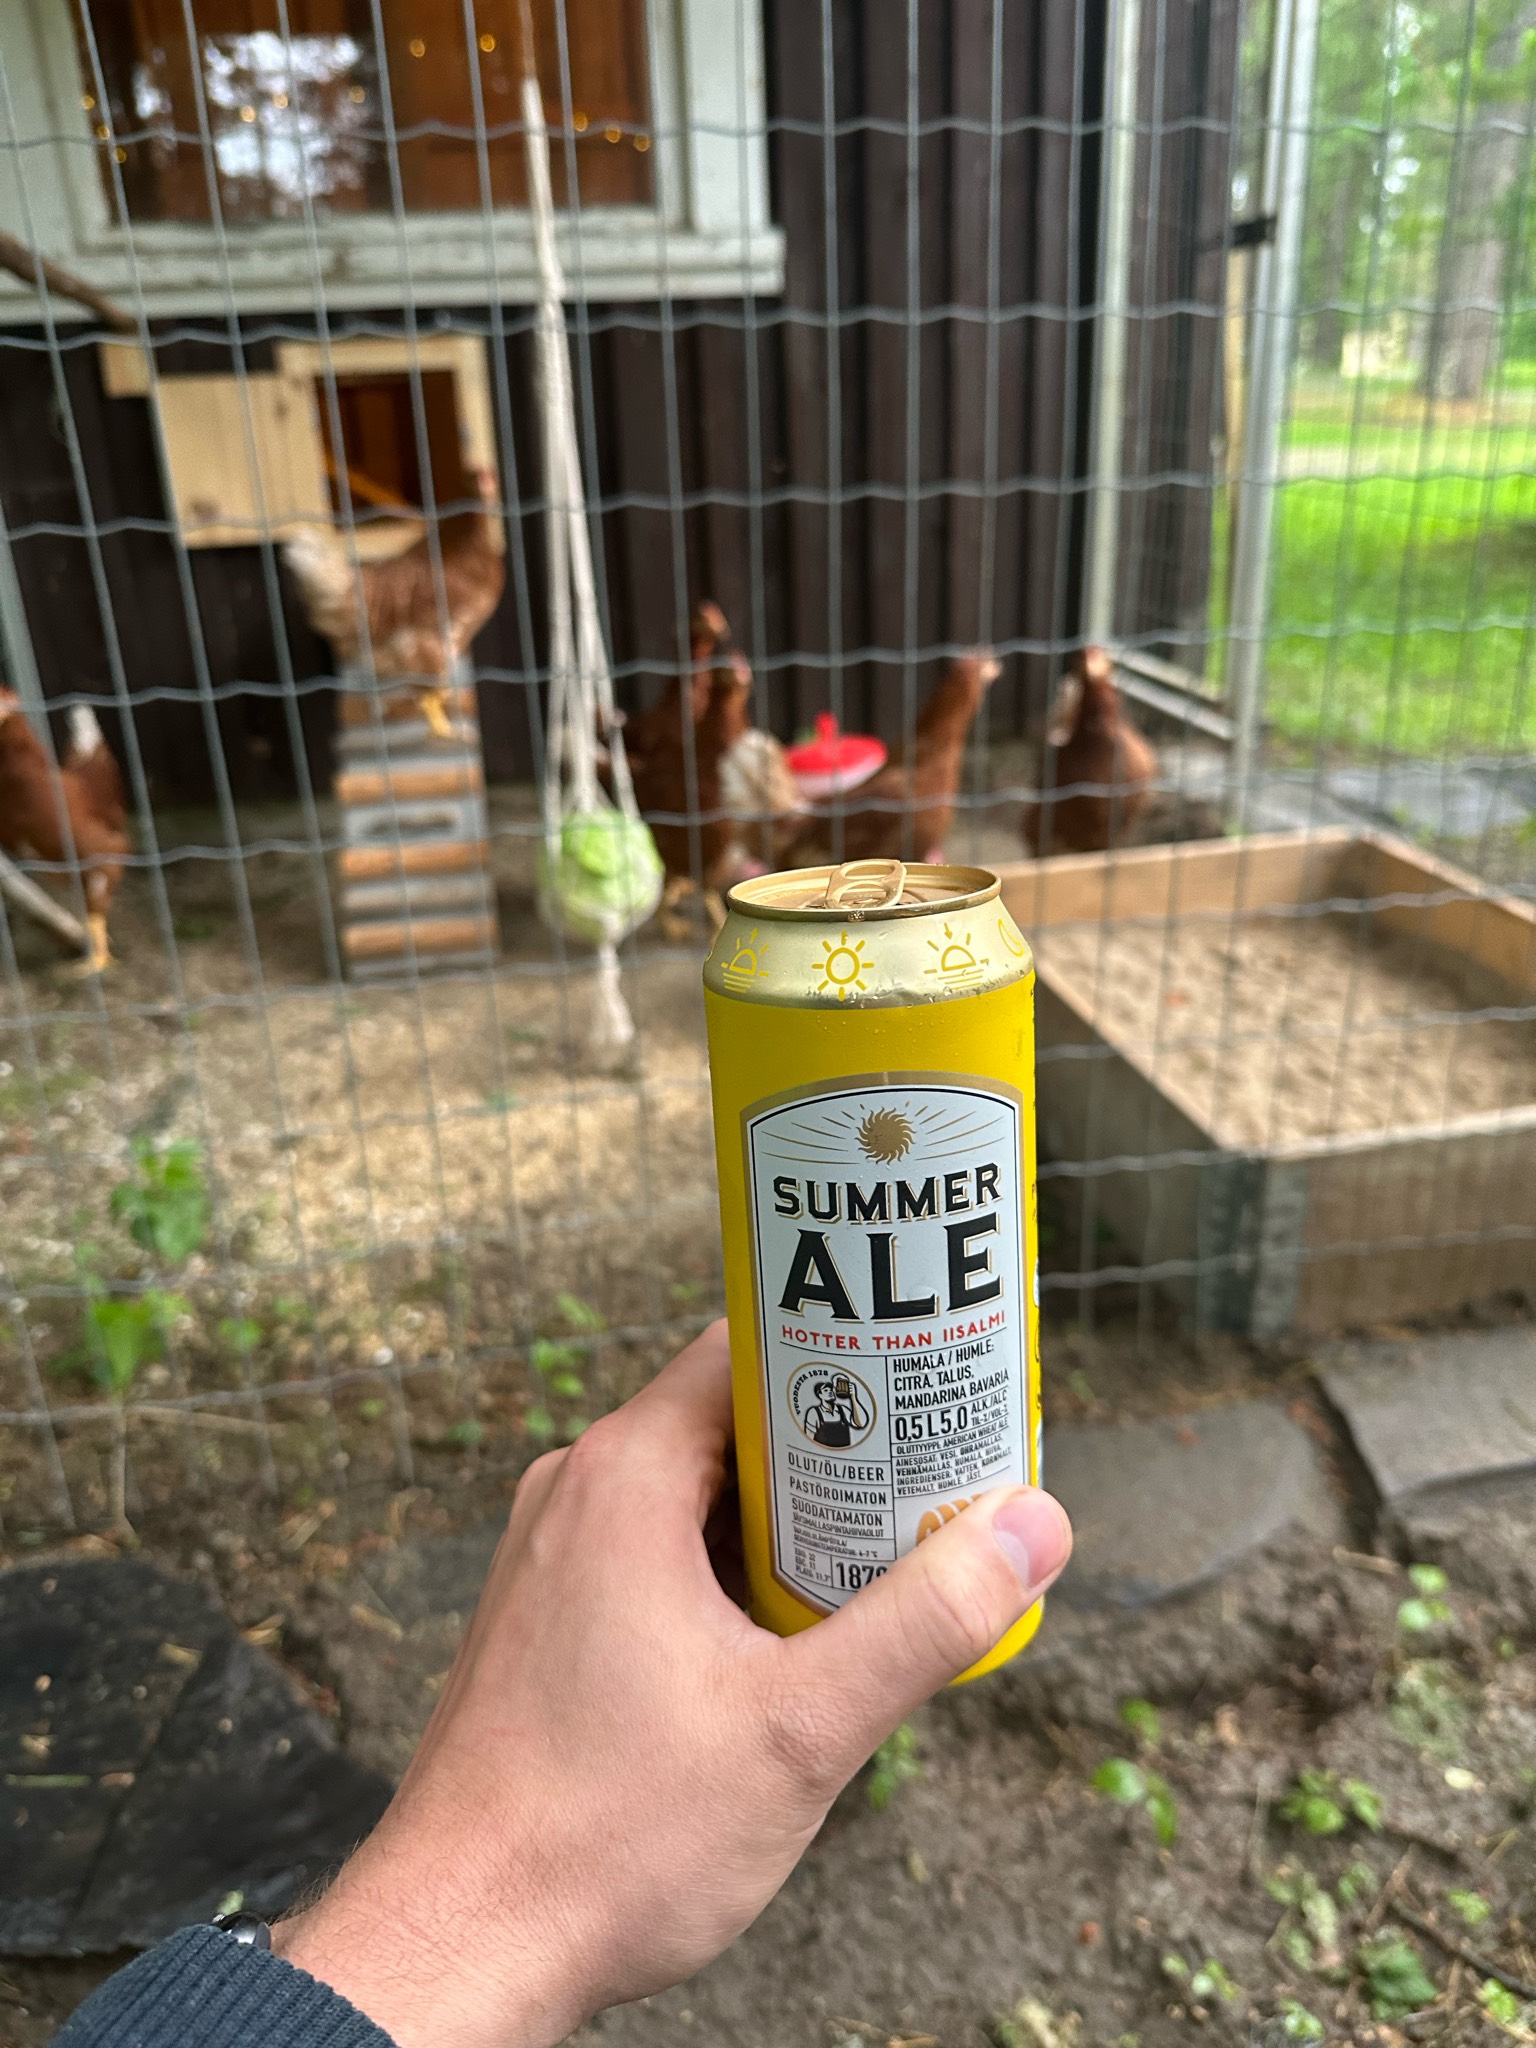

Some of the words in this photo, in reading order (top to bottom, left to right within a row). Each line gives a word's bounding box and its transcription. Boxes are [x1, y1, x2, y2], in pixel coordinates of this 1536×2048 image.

[773, 1162, 1003, 1224] SUMMER
[777, 1211, 1004, 1324] ALE
[781, 1325, 861, 1350] HOTTER
[872, 1331, 932, 1350] THAN
[943, 1310, 1005, 1342] IISALMI
[893, 1353, 945, 1373] HUMALA
[947, 1350, 953, 1366] /
[955, 1338, 995, 1363] HUMLE:
[792, 1373, 809, 1415] VUODESTA
[808, 1369, 829, 1378] 1878
[894, 1385, 967, 1410] MANDARINA
[969, 1367, 1010, 1396] BAVARIA
[894, 1414, 923, 1442] 0,5
[927, 1412, 939, 1437] L
[940, 1405, 968, 1435] 5,0
[943, 1431, 977, 1448] AMERICAN
[977, 1422, 998, 1438] WHEAT
[997, 1416, 1009, 1431] ALE
[788, 1451, 885, 1481] OLUT/ÖL/BEER
[789, 1475, 887, 1505] PASTÖROIMATON
[792, 1498, 883, 1526] SUODATTAMATON
